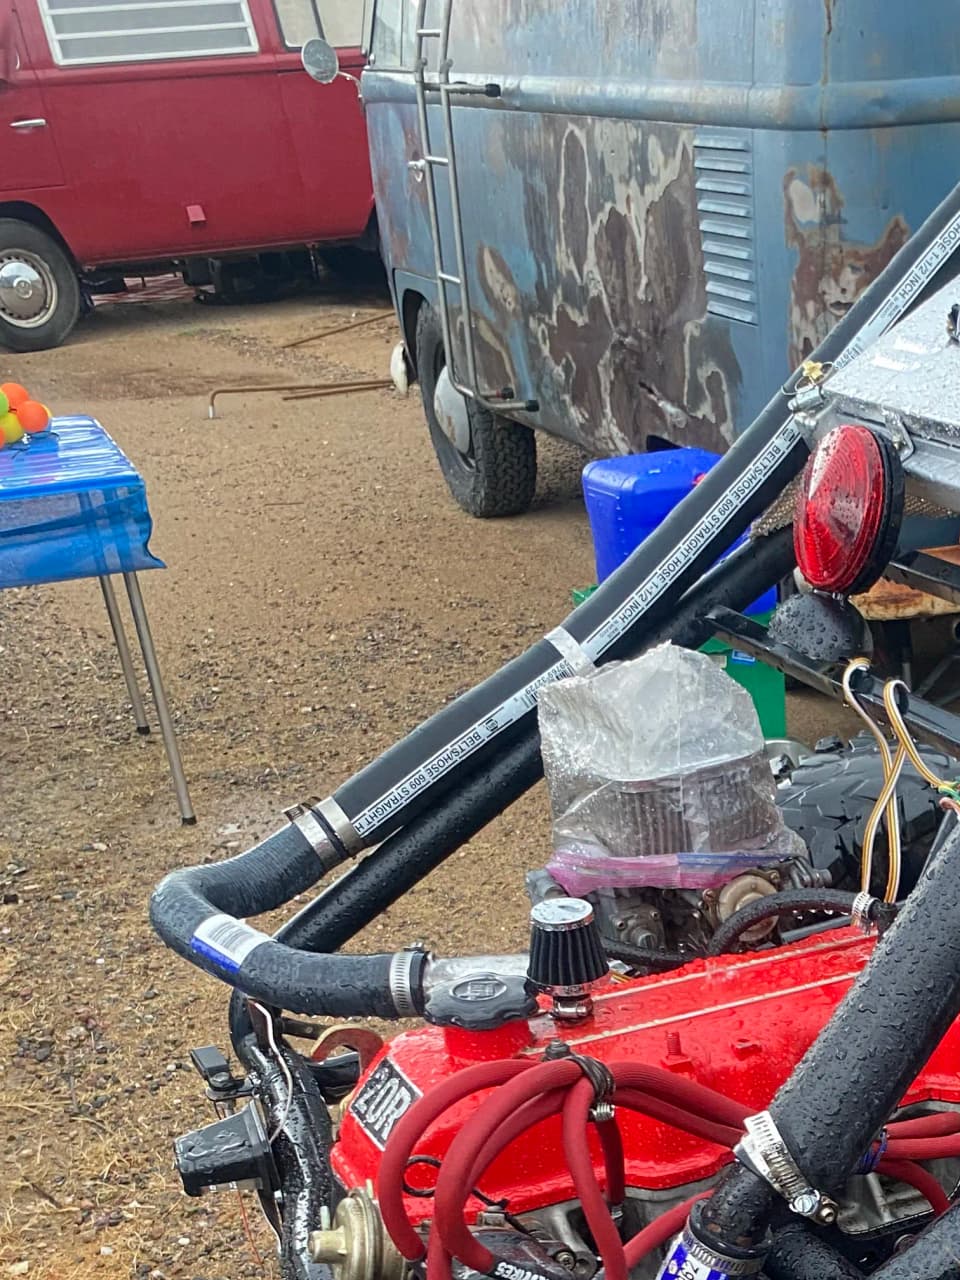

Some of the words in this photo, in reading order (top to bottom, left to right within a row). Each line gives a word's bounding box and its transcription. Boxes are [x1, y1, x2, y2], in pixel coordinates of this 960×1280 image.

[918, 251, 940, 275] 1-1/2
[898, 273, 922, 299] INCH
[731, 444, 782, 501] BELTS/HOSE
[717, 498, 734, 516] 609
[680, 514, 720, 560] STRAIGHT
[656, 556, 682, 583] HOSE
[638, 581, 659, 603] 1-1/2
[618, 599, 641, 624] INCH
[424, 731, 482, 778] BELTS/HOSE
[408, 773, 426, 790] 609
[362, 786, 410, 826] STRAIGHT
